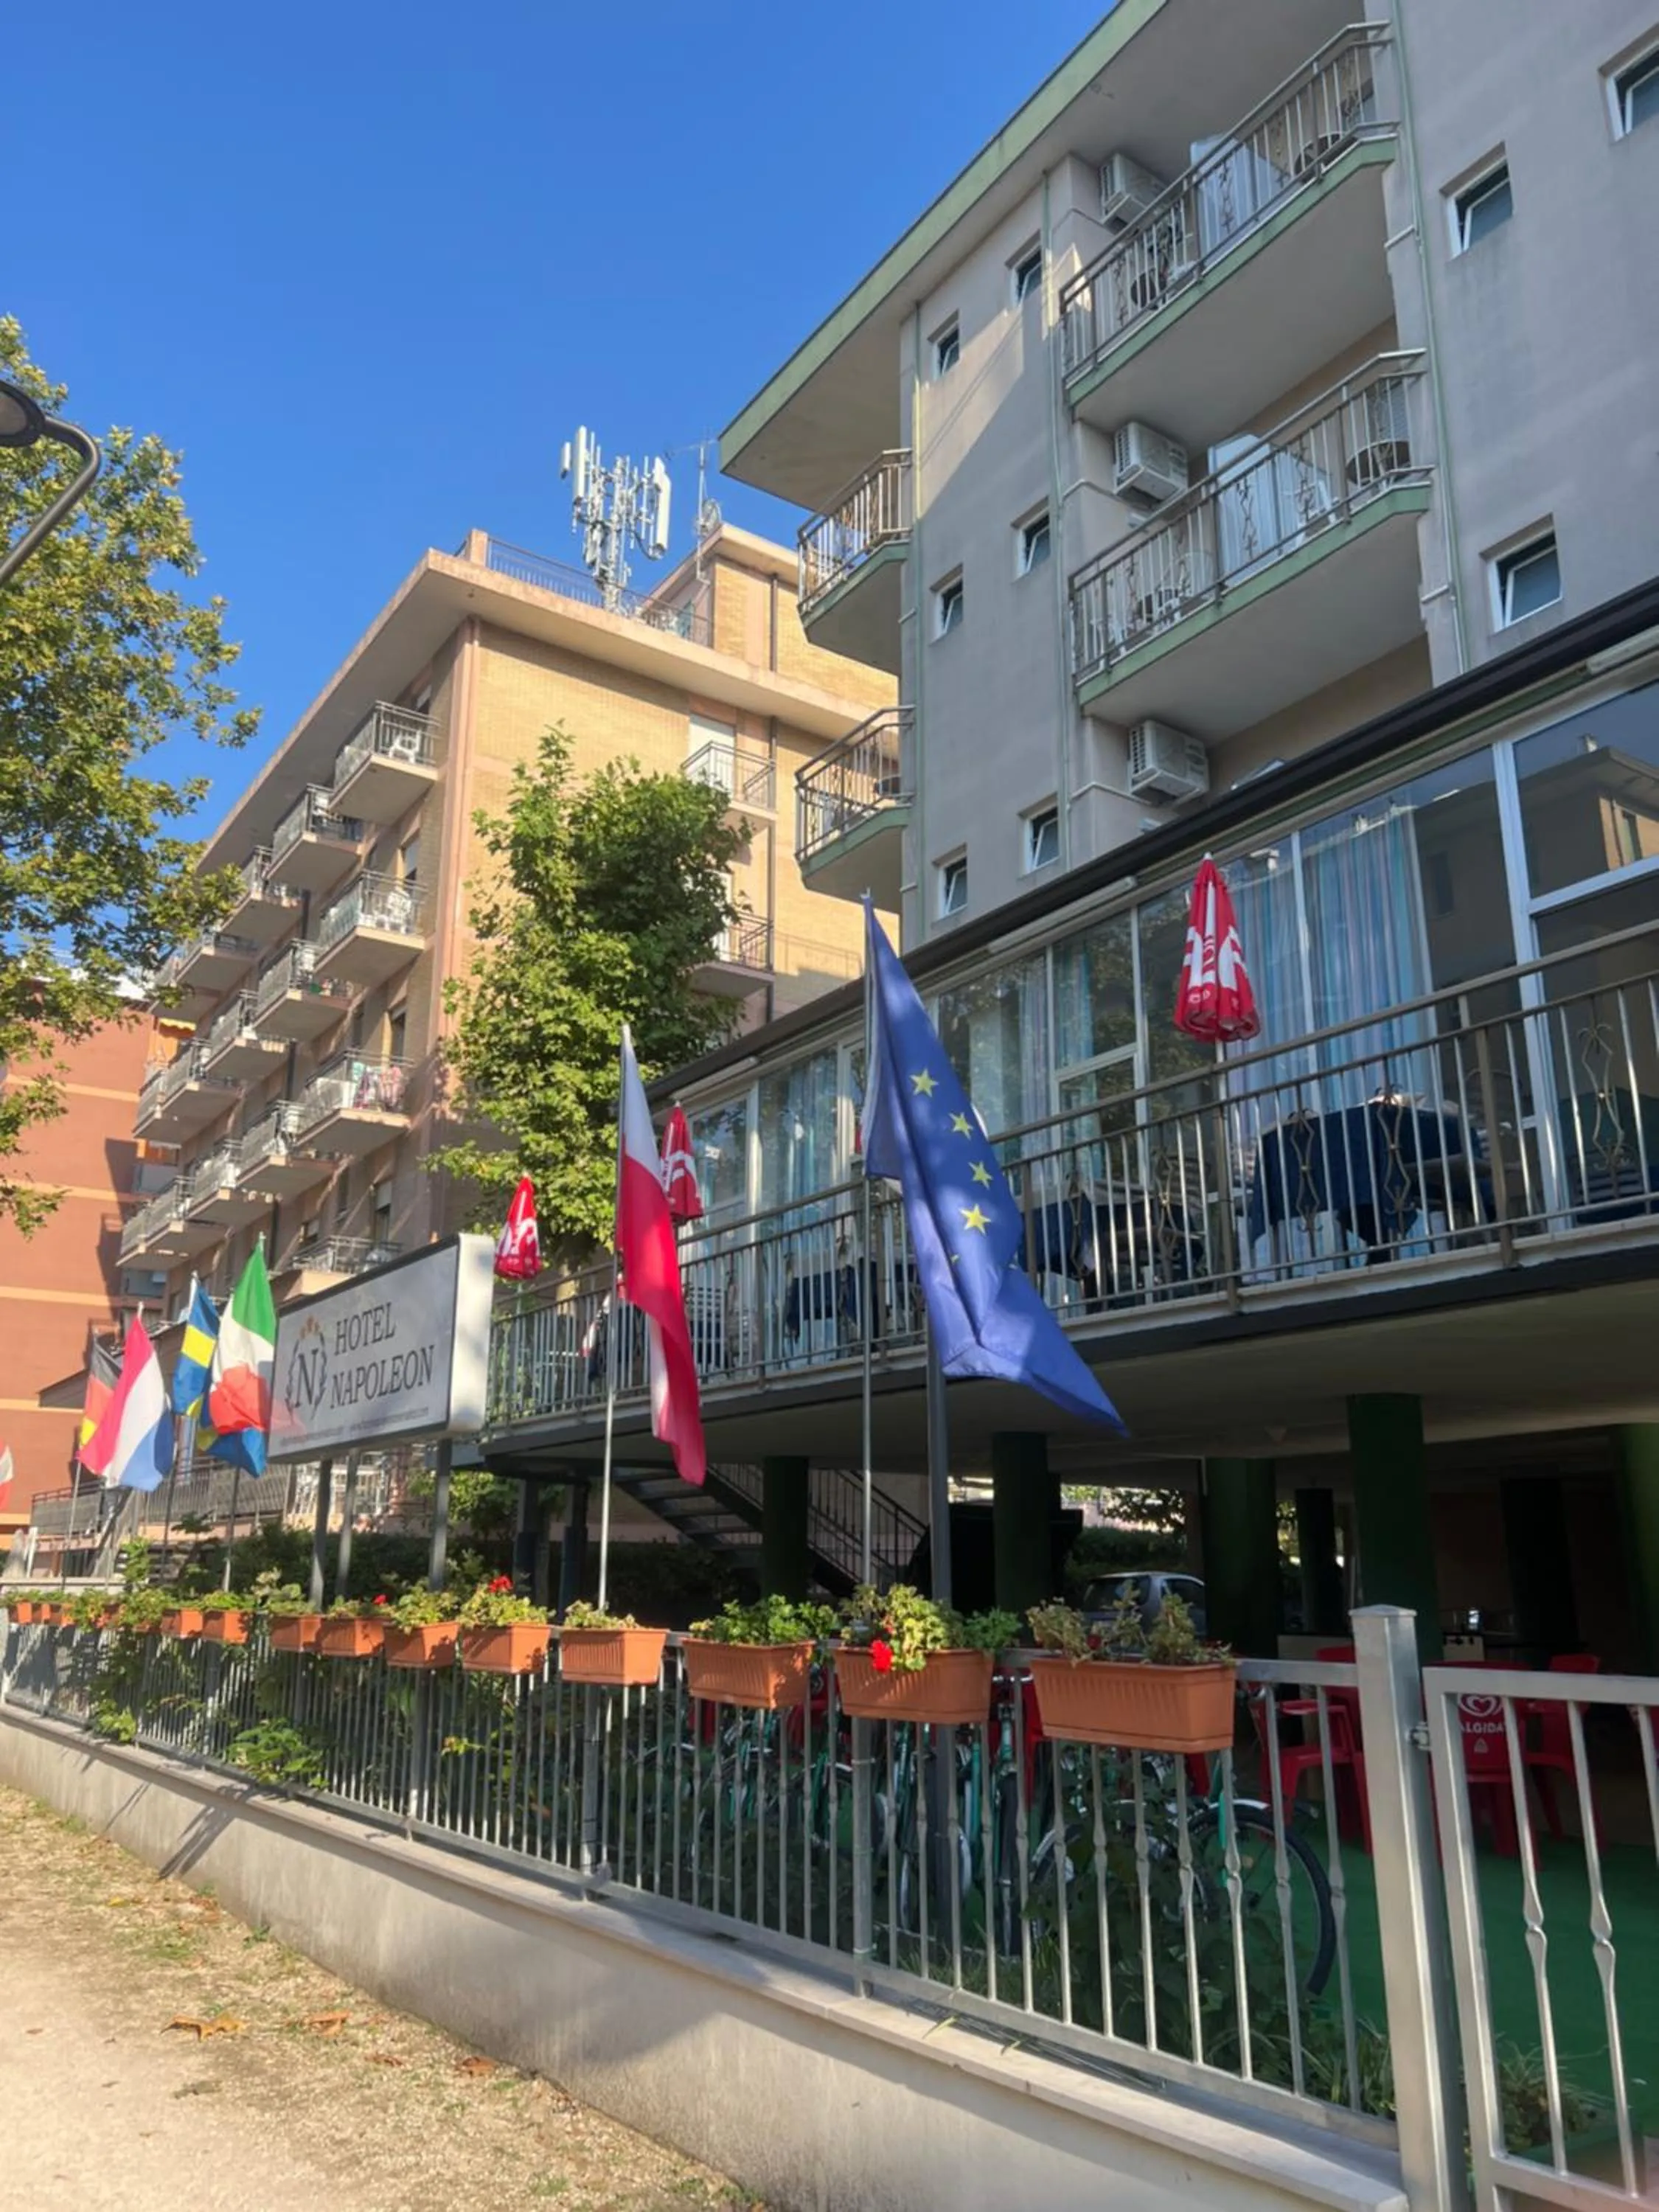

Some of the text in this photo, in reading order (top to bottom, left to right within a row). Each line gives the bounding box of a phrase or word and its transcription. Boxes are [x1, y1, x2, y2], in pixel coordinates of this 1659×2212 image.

[334, 1301, 395, 1357] HOTEL
[293, 1347, 319, 1408] N
[330, 1344, 435, 1408] NAPOLEON
[1460, 1721, 1503, 1733] LGIDA
